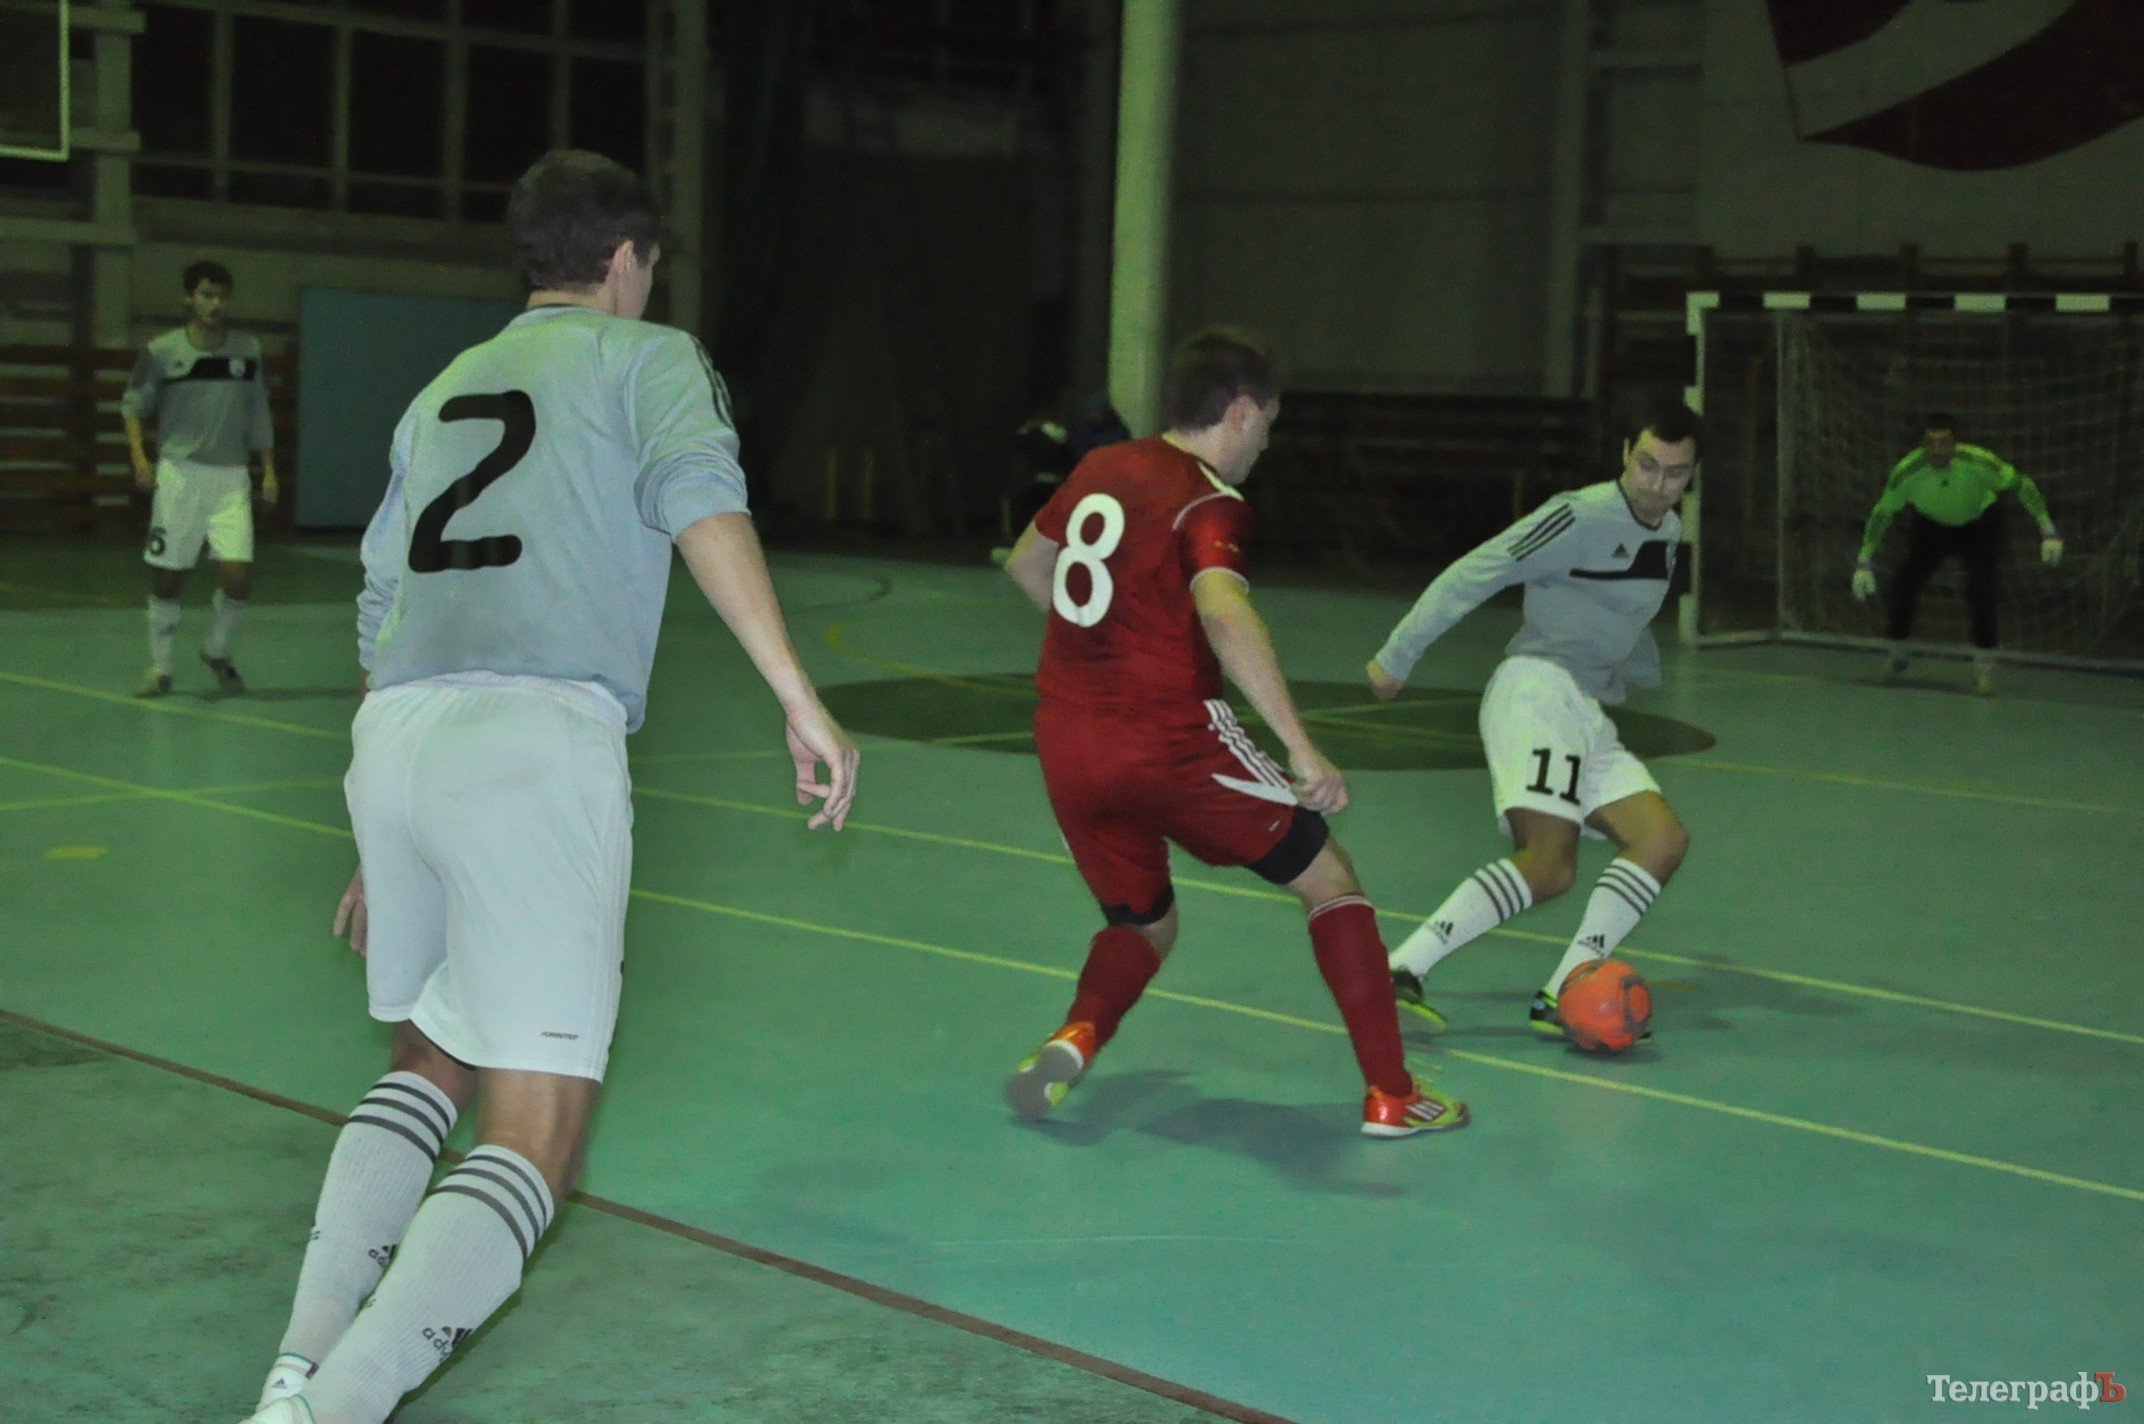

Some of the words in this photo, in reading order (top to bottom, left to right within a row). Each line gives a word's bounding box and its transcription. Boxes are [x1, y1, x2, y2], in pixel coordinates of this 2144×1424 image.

[408, 390, 537, 573] 2
[1053, 492, 1125, 628] 8
[1526, 748, 1581, 806] 11
